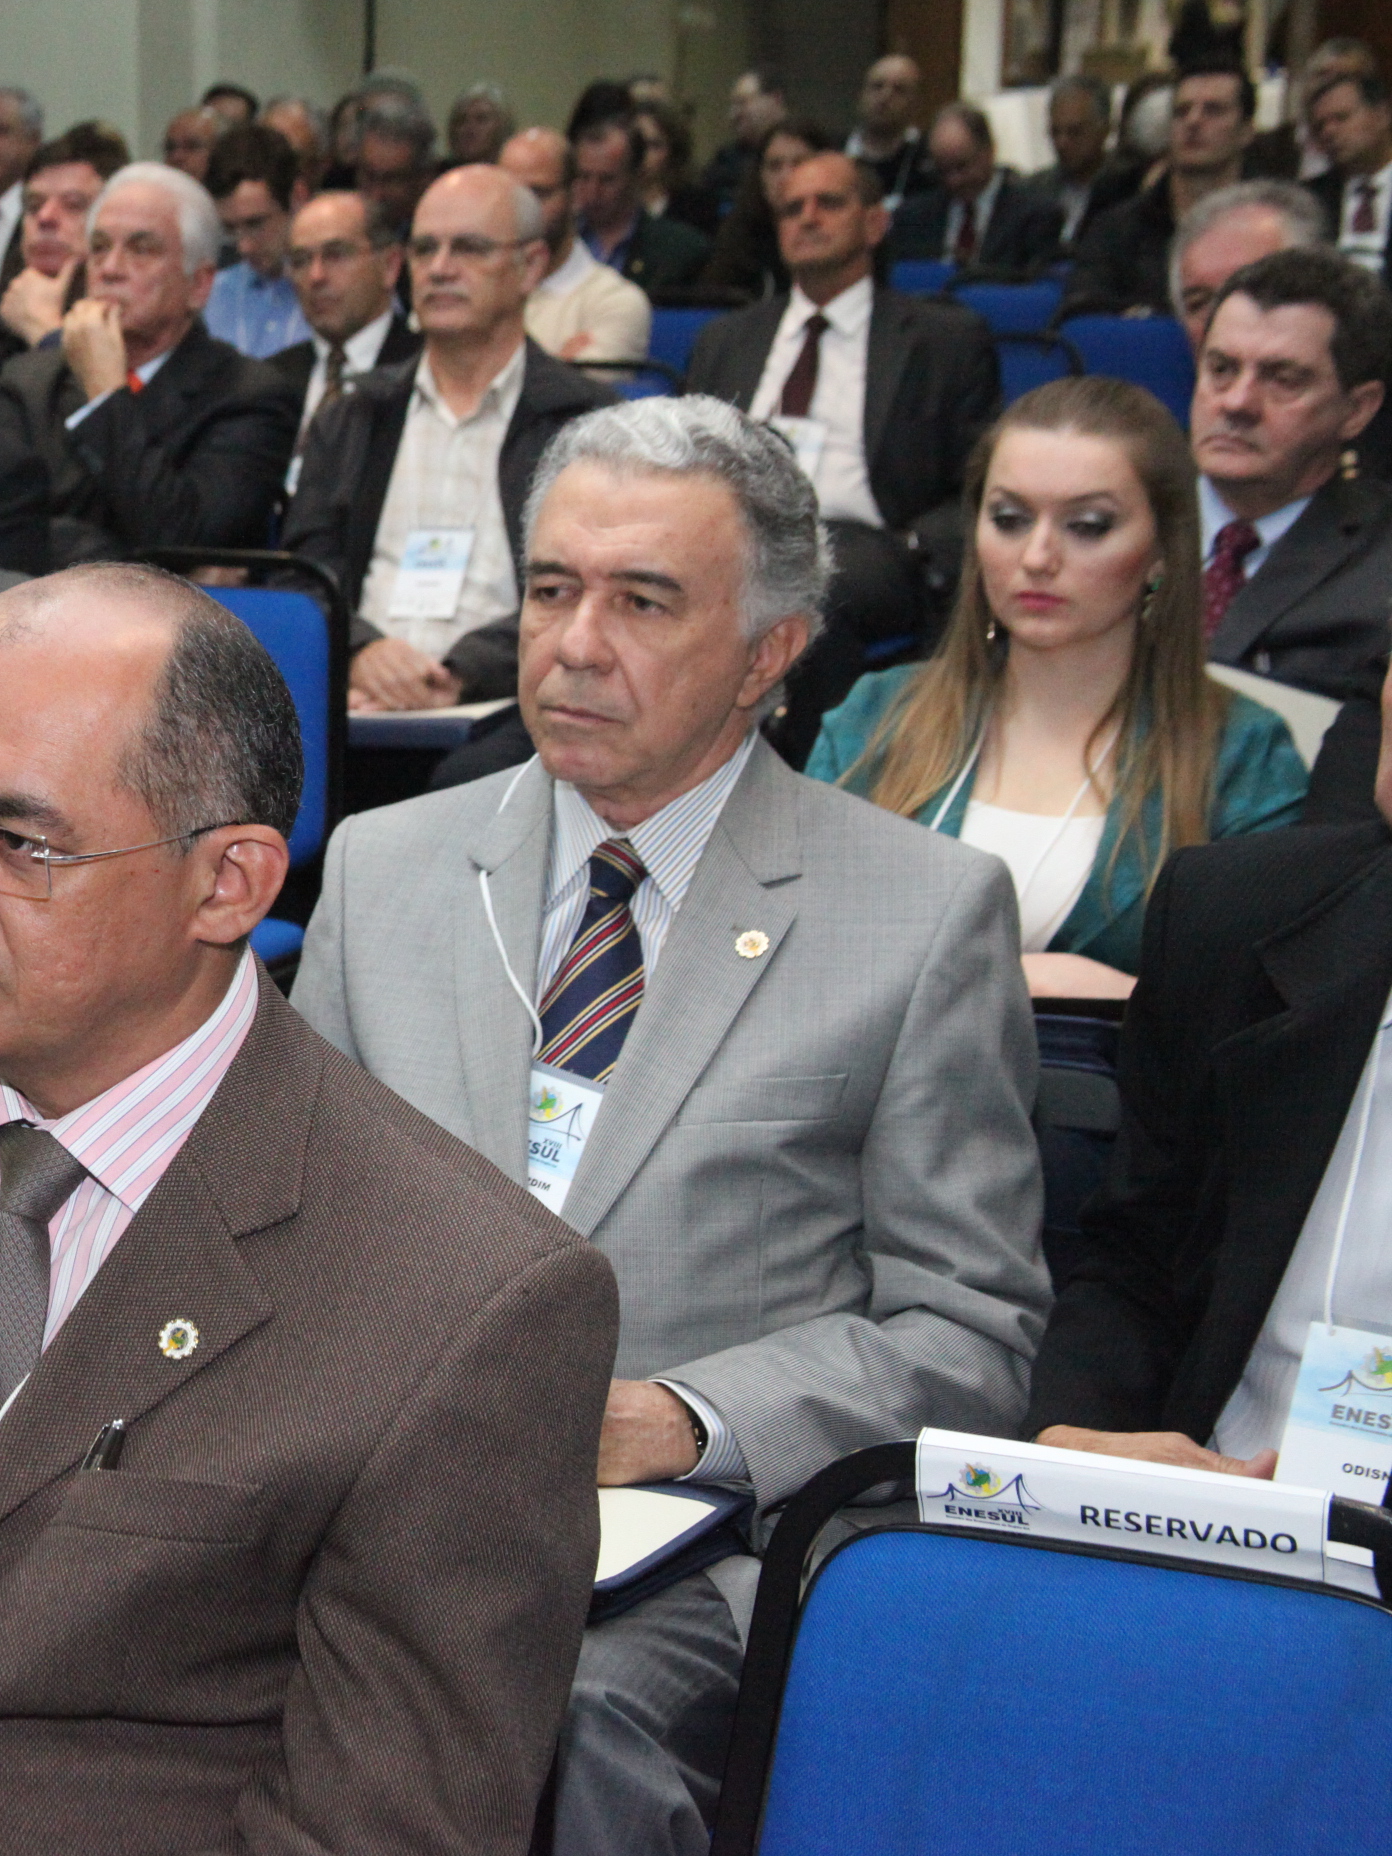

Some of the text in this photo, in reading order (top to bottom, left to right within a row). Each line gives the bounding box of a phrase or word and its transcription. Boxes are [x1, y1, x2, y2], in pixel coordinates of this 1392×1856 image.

[528, 1140, 560, 1162] SUL
[528, 1177, 551, 1191] DIM
[944, 1504, 1030, 1526] ENESUL
[1080, 1505, 1298, 1554] RESERVADO
